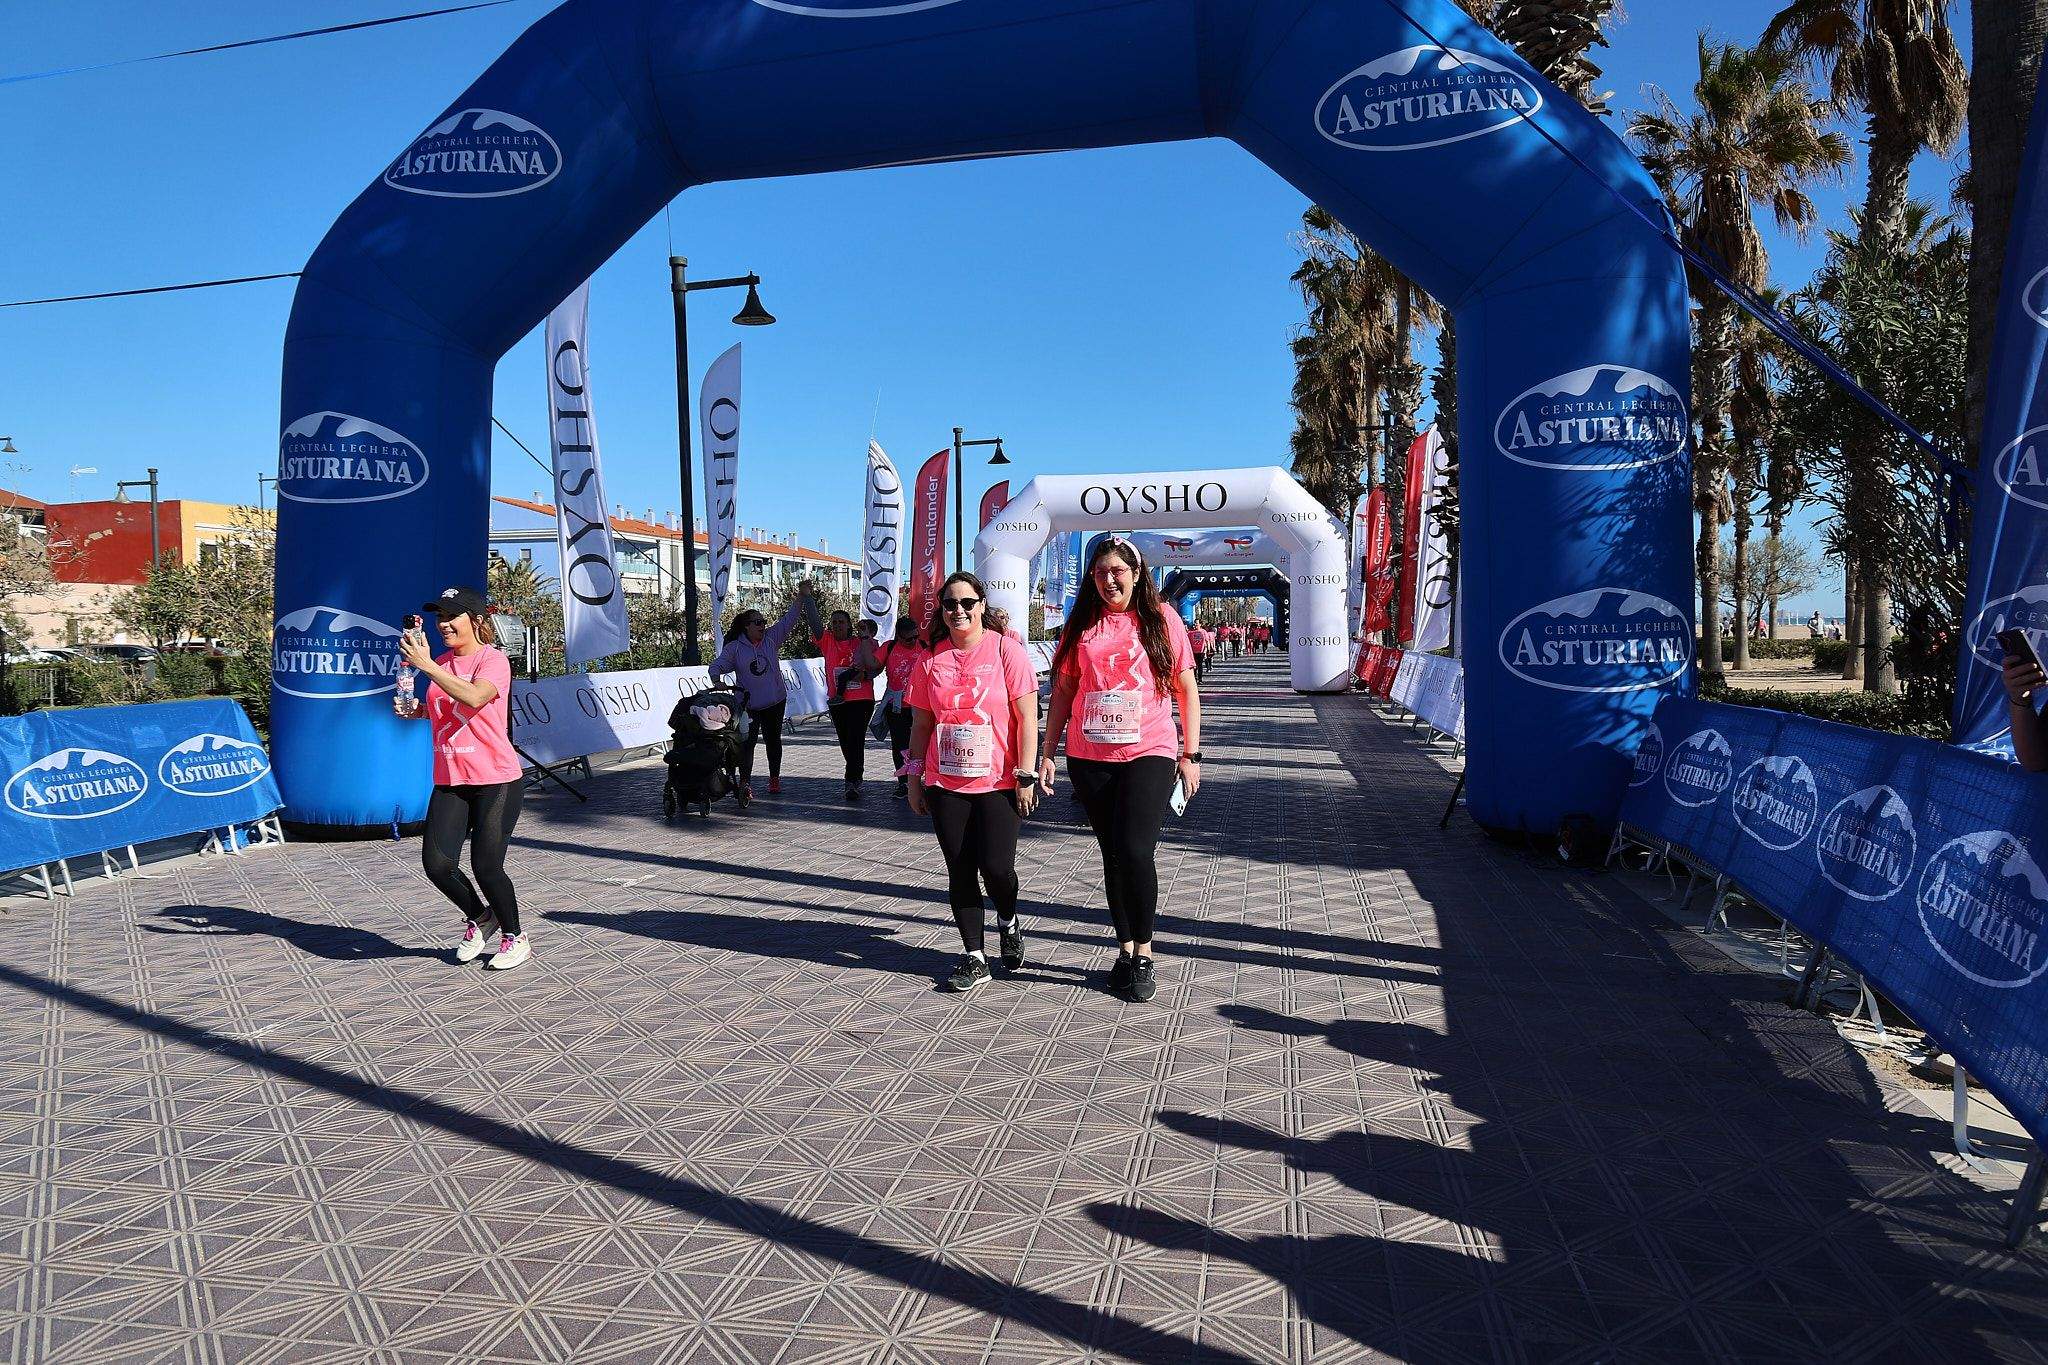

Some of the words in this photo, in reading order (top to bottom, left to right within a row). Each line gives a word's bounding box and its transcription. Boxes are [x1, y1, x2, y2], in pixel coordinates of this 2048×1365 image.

[1365, 78, 1440, 98] CENTRAL
[1447, 75, 1517, 86] LECHERA
[1333, 88, 1530, 135] ASTURIANA
[421, 136, 471, 151] CENTRAL
[477, 136, 539, 146] LECHERA
[391, 150, 548, 179] ASTURIANA
[1540, 401, 1615, 416] CENTRAL
[1622, 400, 1678, 411] LECHERA
[1508, 410, 1681, 450] ASTURIANA
[288, 443, 335, 453] CENTRAL
[341, 443, 408, 457] LECHERA
[279, 448, 414, 484] ASTURIANA
[554, 340, 615, 606] OYSHO
[709, 397, 738, 601] OYSHO
[1080, 482, 1228, 516] OYSHO
[924, 476, 939, 557] Santander
[995, 522, 1038, 532] OYSHO
[1271, 512, 1317, 523] OYSHO
[865, 464, 900, 617] OYSHO
[1066, 554, 1080, 598] Marlene
[1195, 575, 1258, 583] VOLVO
[1298, 574, 1341, 585] OYSHO
[1298, 636, 1341, 647] OYSHO
[1545, 623, 1618, 635] CENTRAL
[1626, 622, 1681, 632] LECHERA
[281, 637, 327, 647] CENTRAL
[334, 638, 400, 649] LECHERA
[1512, 628, 1686, 666] ASTURIANA
[272, 639, 402, 676] ASTURIANA
[576, 682, 650, 718] OYSHO
[1101, 714, 1123, 723] 016
[954, 747, 974, 757] 016
[43, 770, 86, 783] CENTRAL
[89, 766, 132, 777] LECHERA
[170, 757, 266, 785] ASTURIANA
[21, 775, 142, 809] ASTURIANA
[1922, 860, 2038, 972] ASTURIANA
